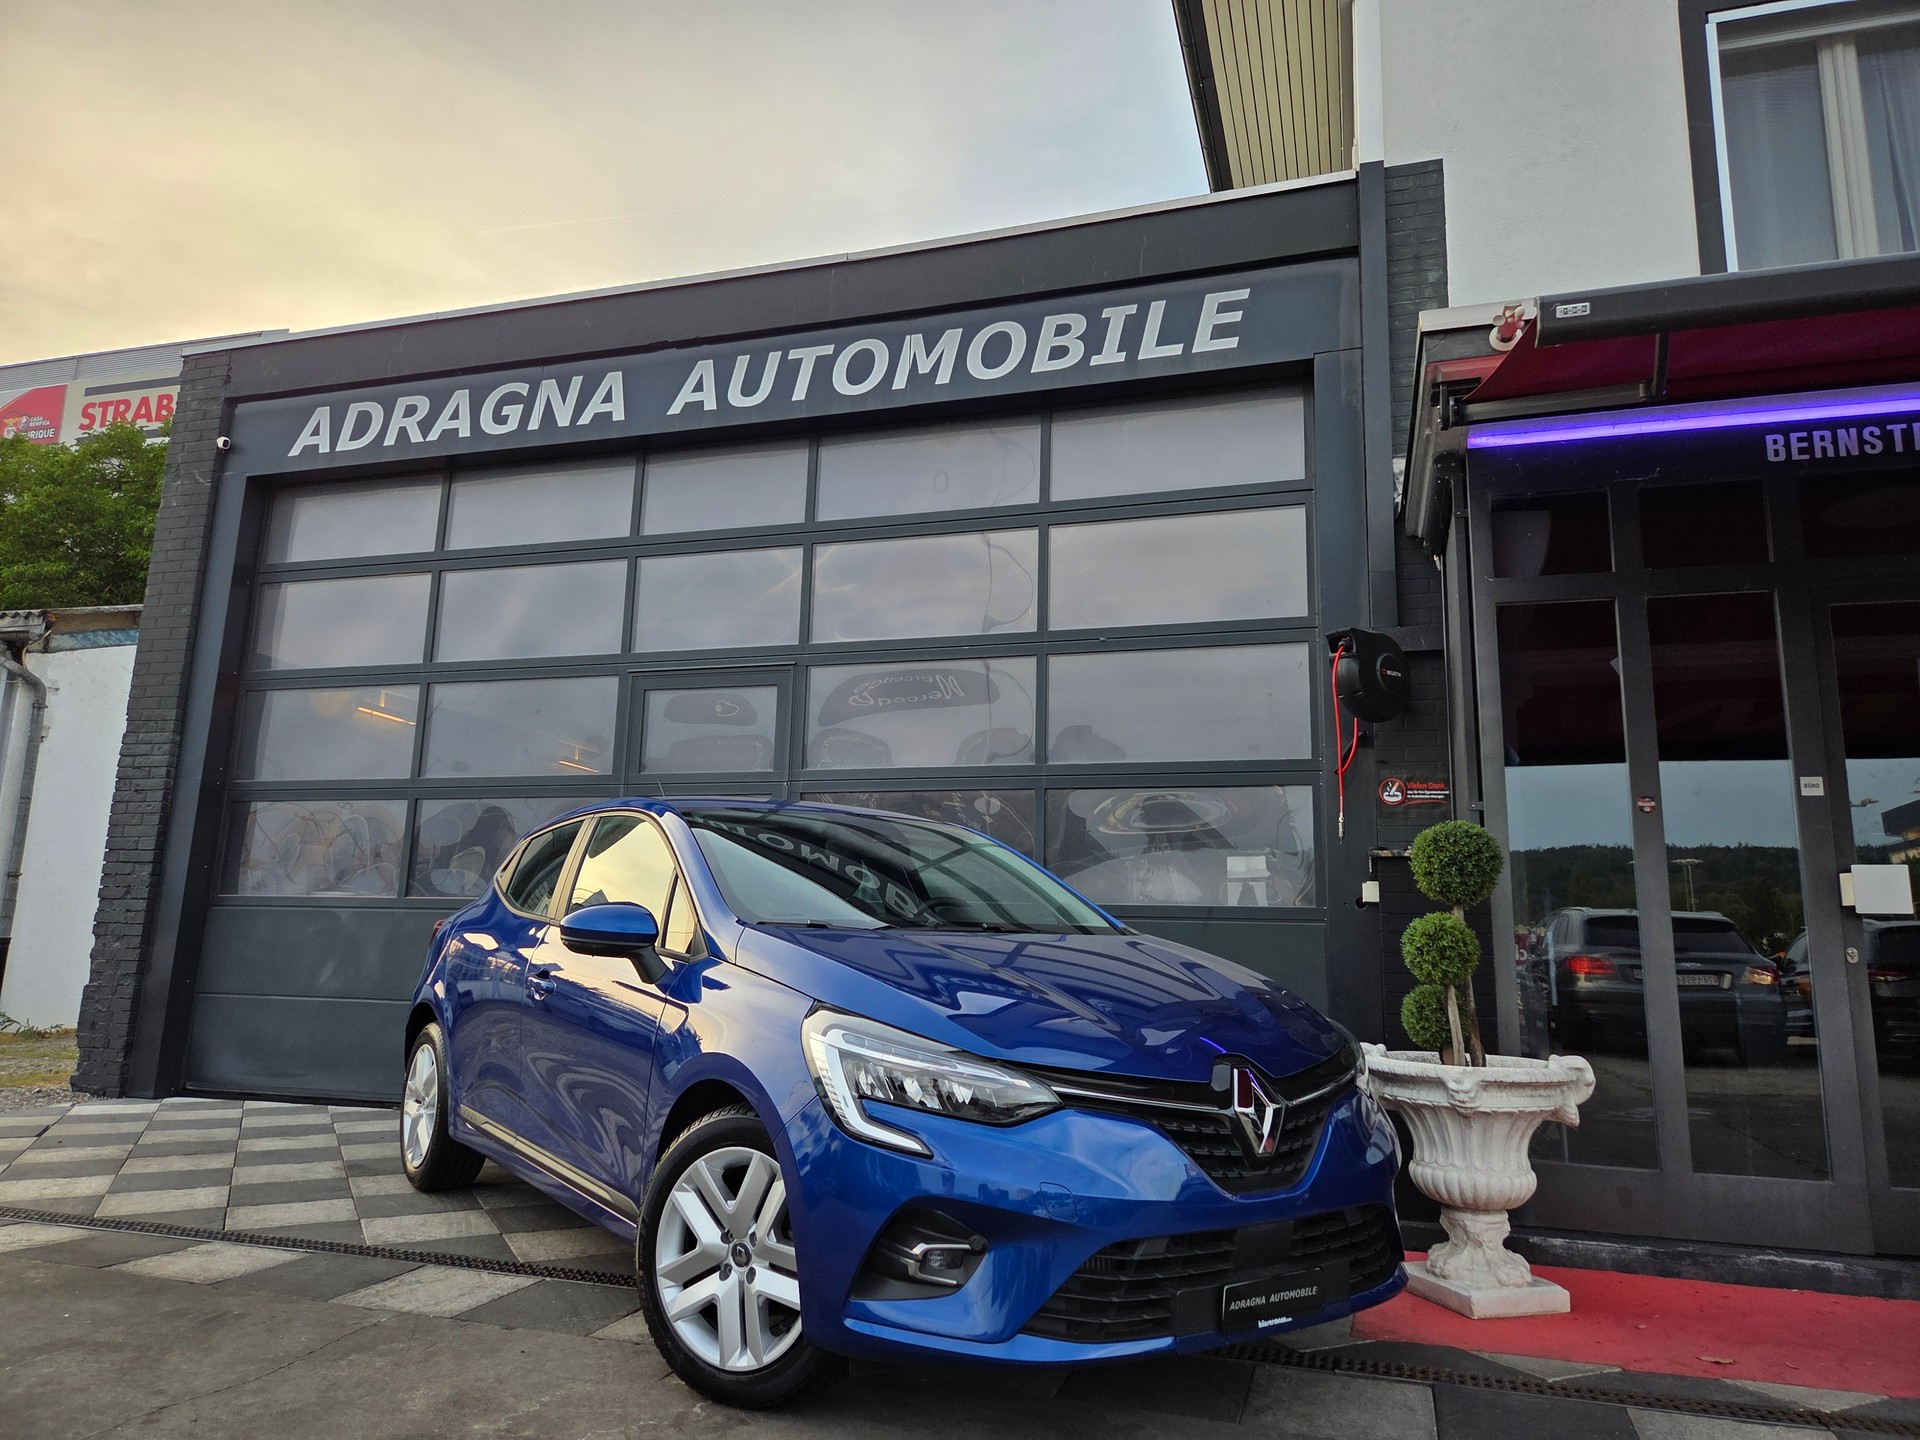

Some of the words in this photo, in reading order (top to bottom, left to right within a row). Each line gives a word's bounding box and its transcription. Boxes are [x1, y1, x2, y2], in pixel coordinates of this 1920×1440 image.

[287, 371, 626, 457] ADRAGNA
[666, 288, 1251, 416] AUTOMOBILE
[78, 393, 175, 431] STRAB
[1229, 1296, 1266, 1311] ADRAGNA
[1269, 1286, 1318, 1303] AUTOMOBILE
